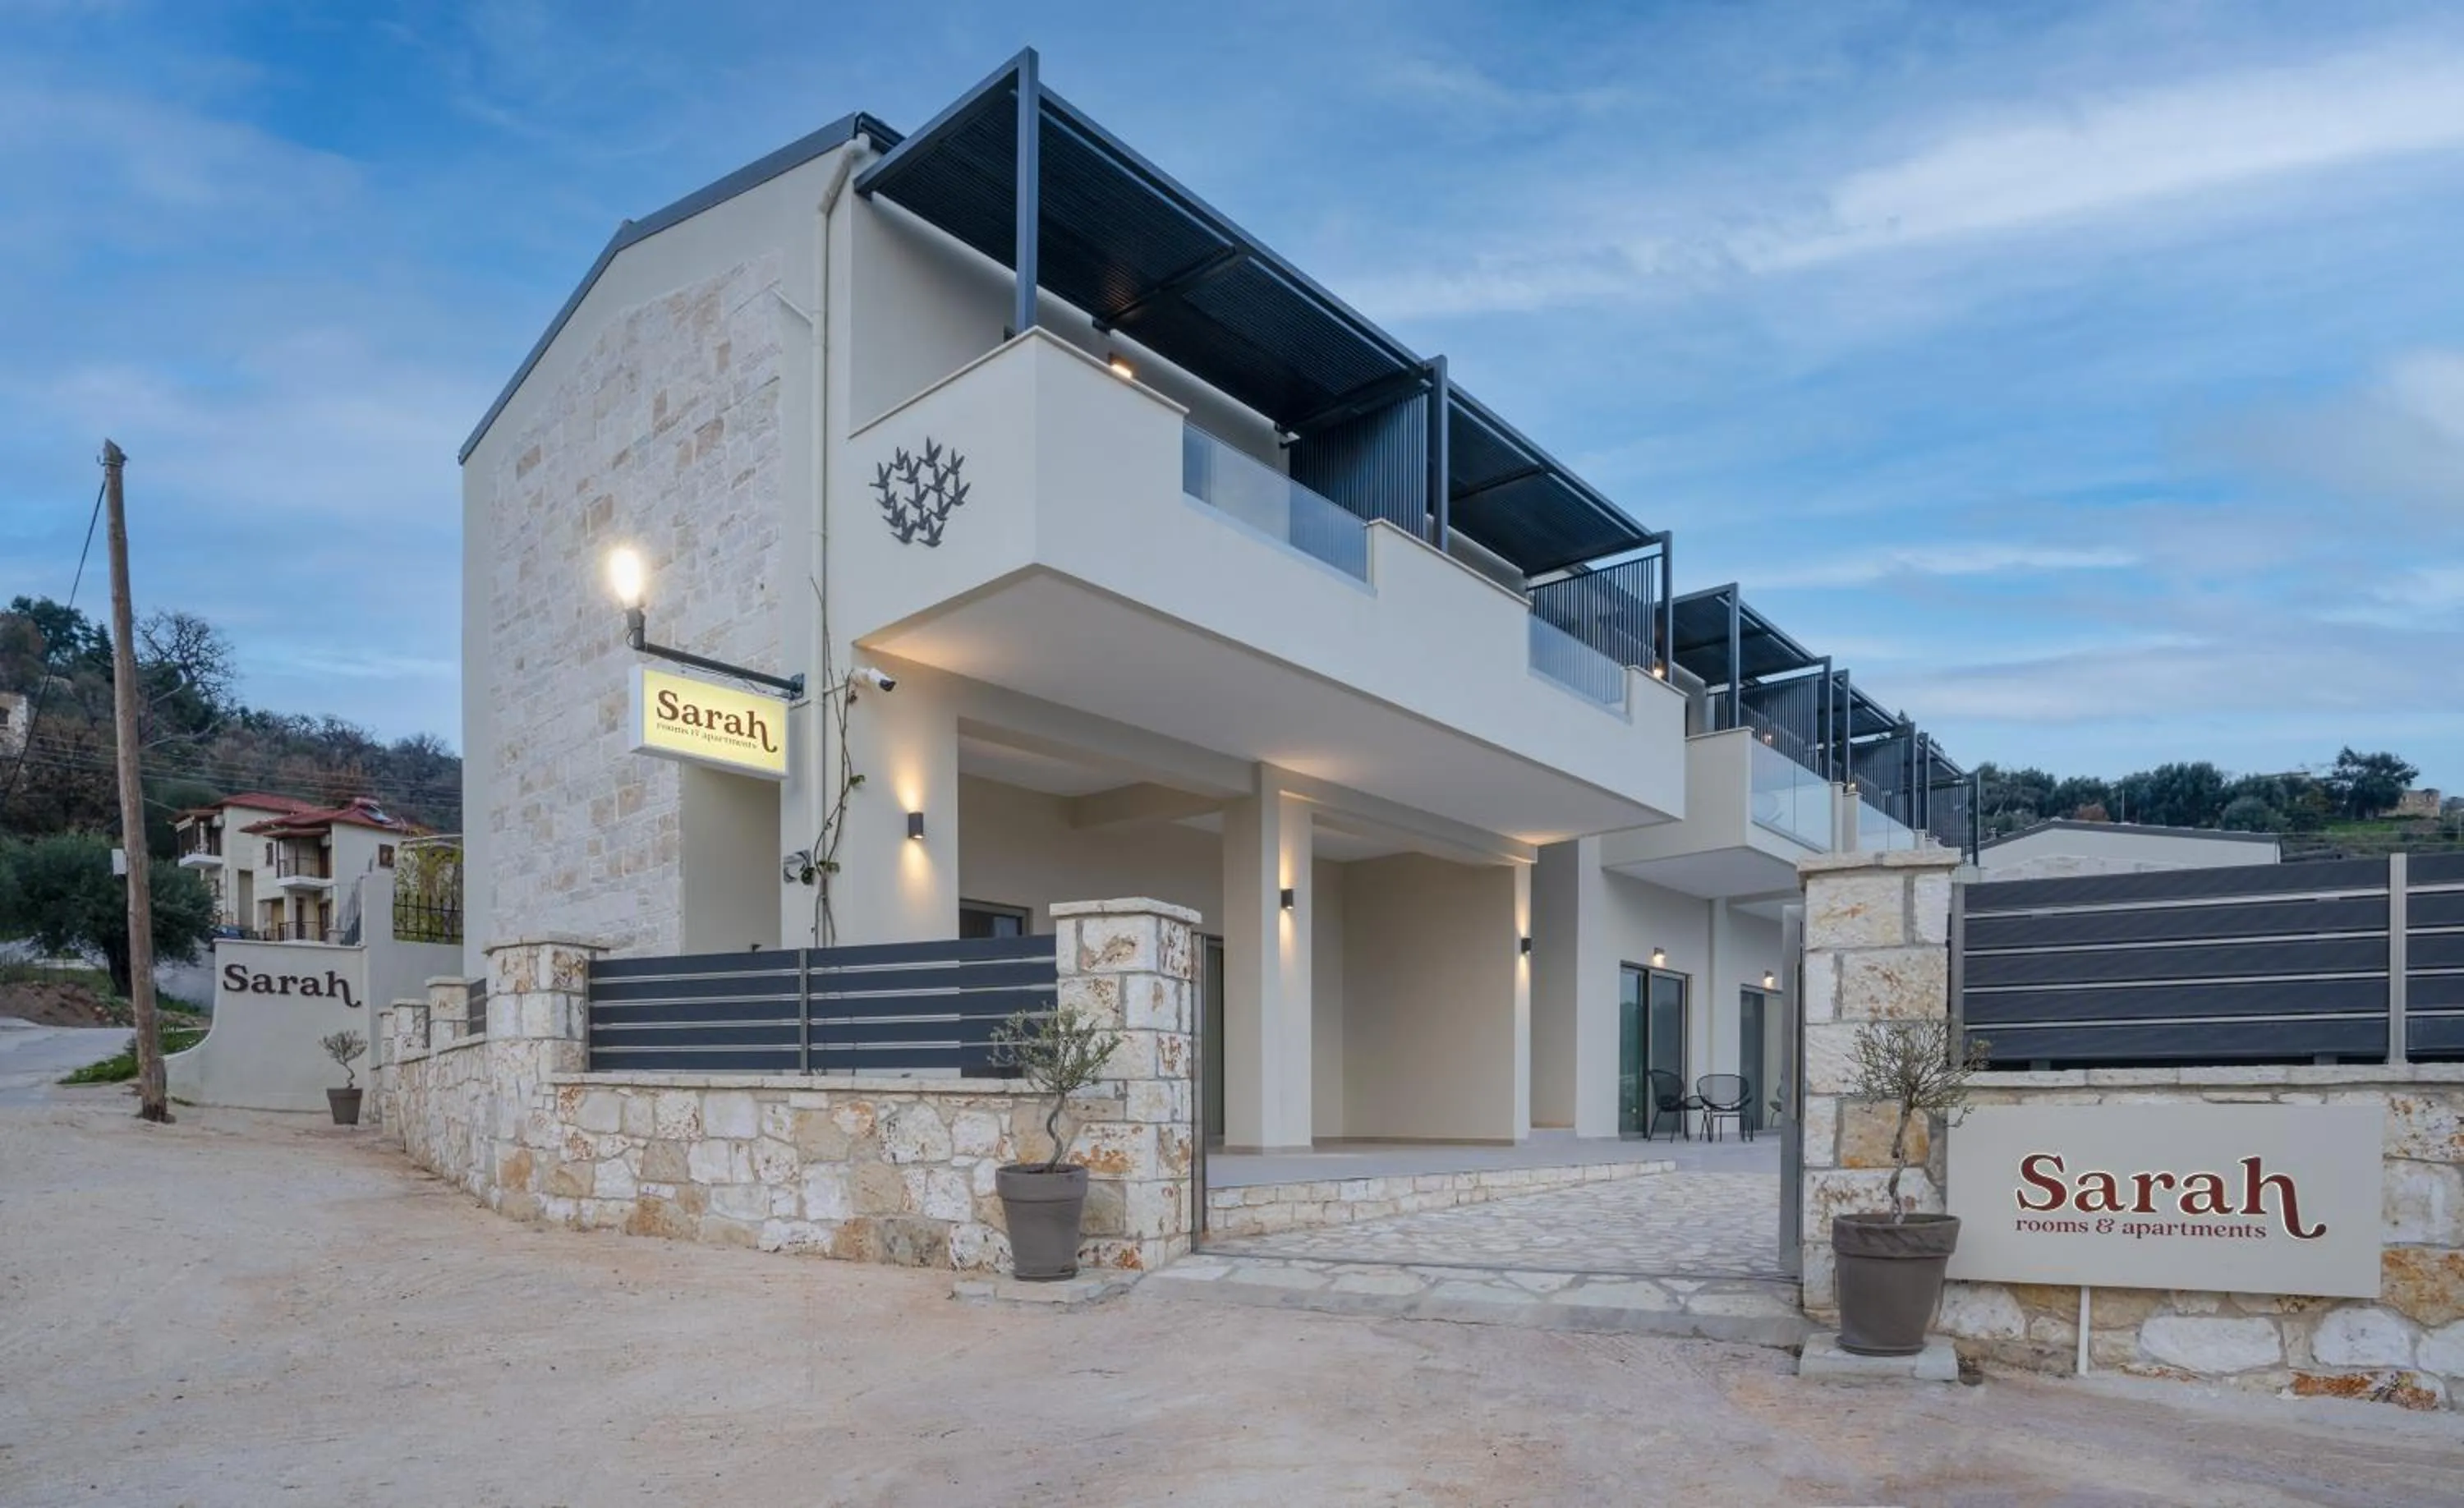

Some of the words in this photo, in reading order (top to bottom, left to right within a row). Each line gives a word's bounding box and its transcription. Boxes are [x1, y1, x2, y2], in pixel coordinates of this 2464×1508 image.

[656, 689, 778, 753] Sarah
[223, 963, 361, 1008] Sarah
[2015, 1152, 2328, 1239] Sarah
[2016, 1217, 2089, 1234] rooms
[2095, 1217, 2115, 1234] &
[2122, 1220, 2267, 1239] apartments
